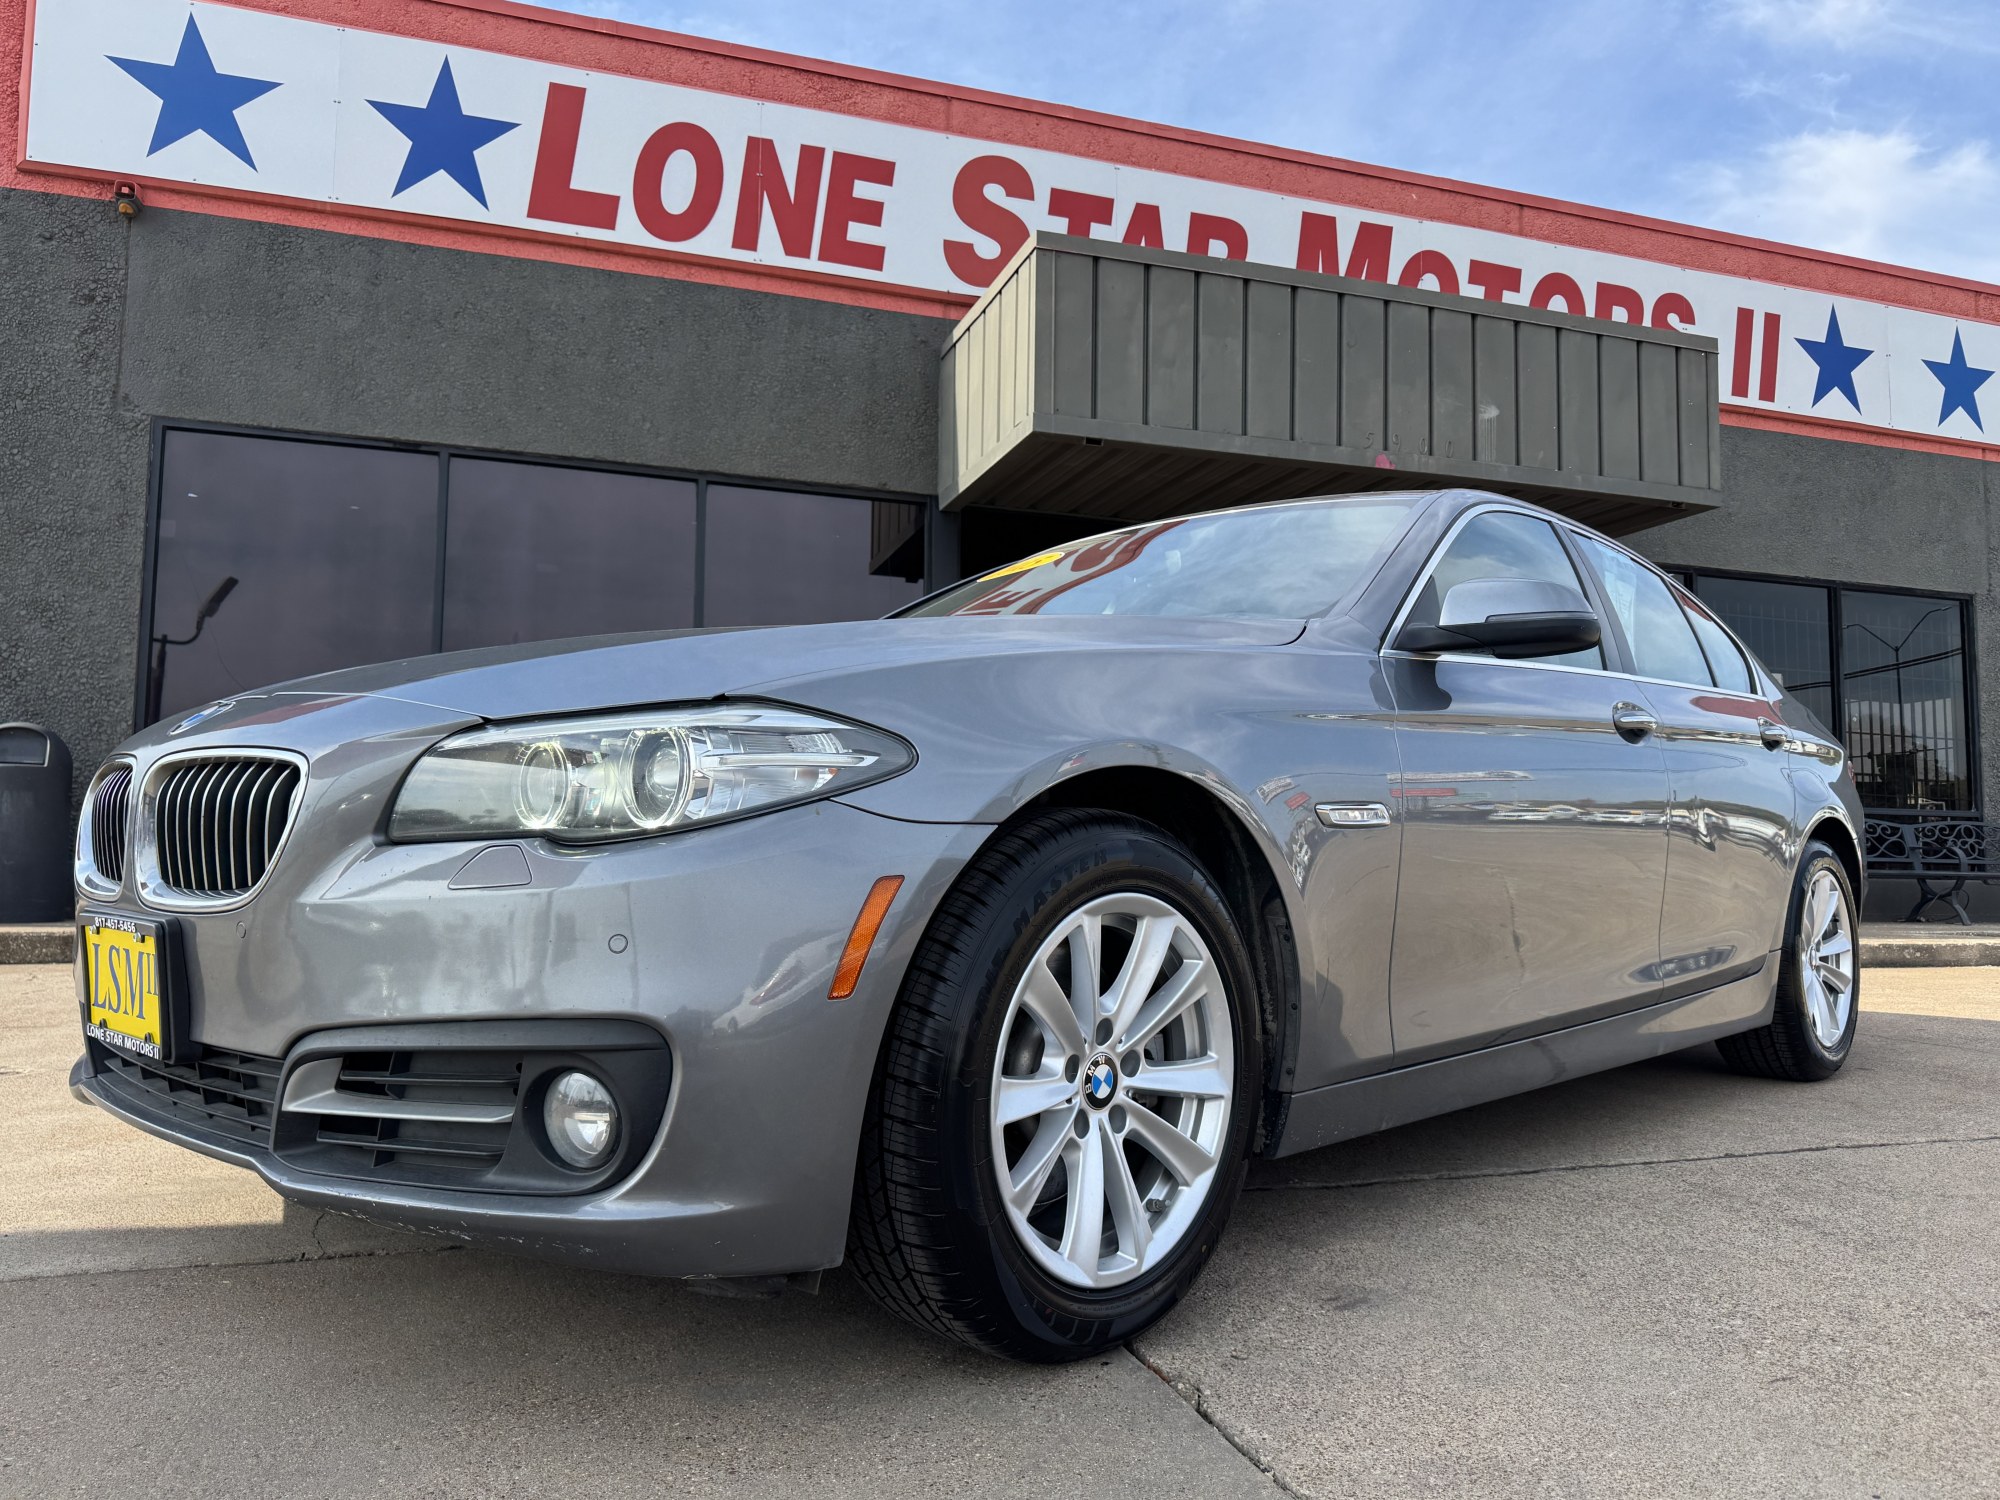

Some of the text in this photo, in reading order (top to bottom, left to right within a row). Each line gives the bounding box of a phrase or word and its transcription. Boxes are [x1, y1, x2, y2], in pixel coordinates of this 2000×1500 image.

[527, 82, 896, 272] LONE
[1731, 307, 1781, 403] II
[87, 1023, 105, 1041] LONE
[106, 1031, 123, 1047] STAR
[124, 1037, 153, 1058] MOTORS
[1085, 1055, 1106, 1094] BMW
